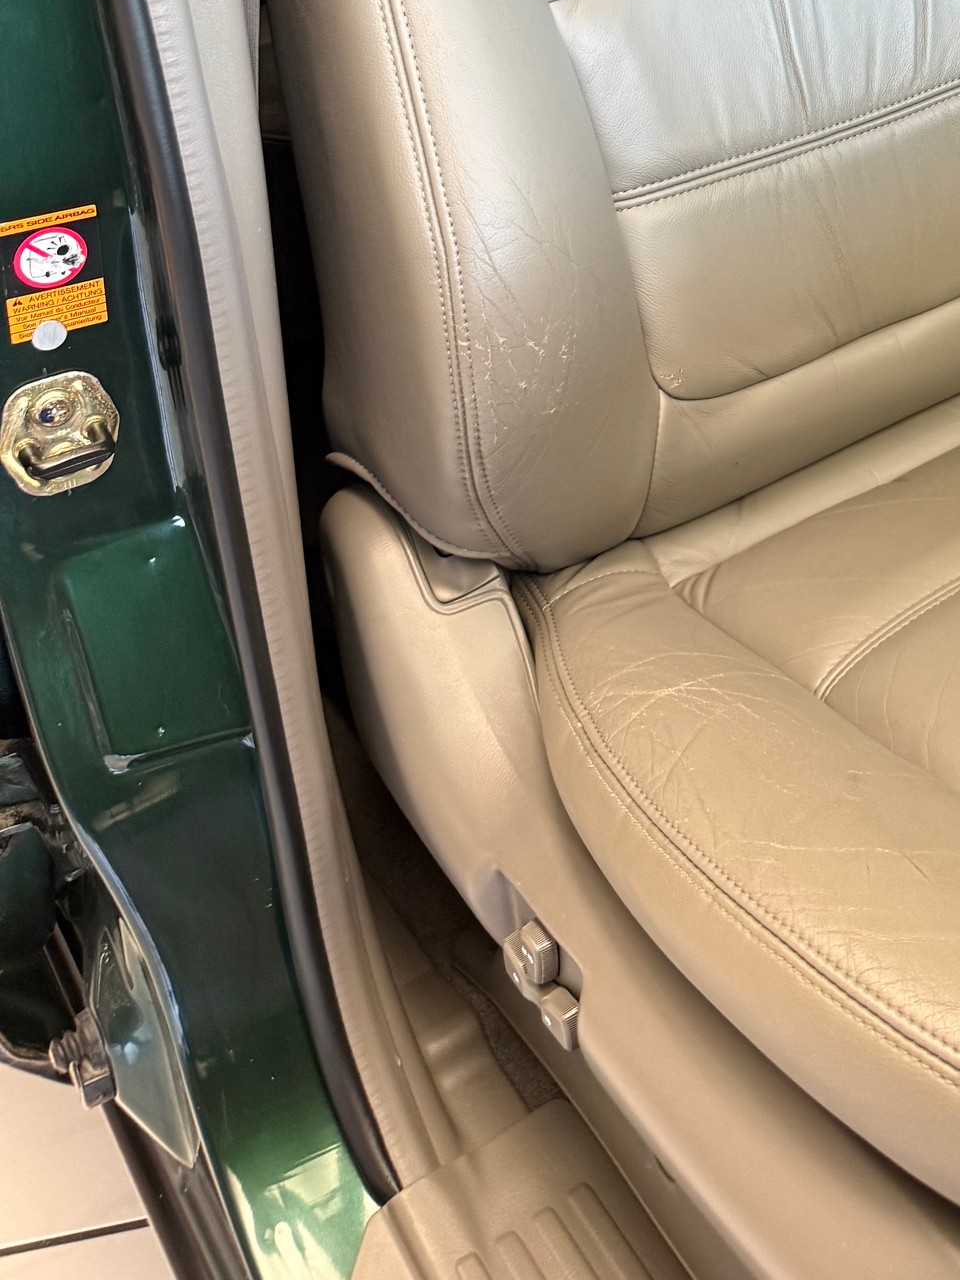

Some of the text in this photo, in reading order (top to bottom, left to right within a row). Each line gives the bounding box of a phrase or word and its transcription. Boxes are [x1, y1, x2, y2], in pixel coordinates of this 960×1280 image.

[0, 208, 95, 232] SRS SIDE AIRBAG
[13, 300, 54, 314] WARNING
[61, 288, 103, 303] ACHTUNG
[29, 281, 100, 302] AVERTISSEMENT
[66, 299, 100, 311] Conducteur
[71, 307, 97, 318] Manual
